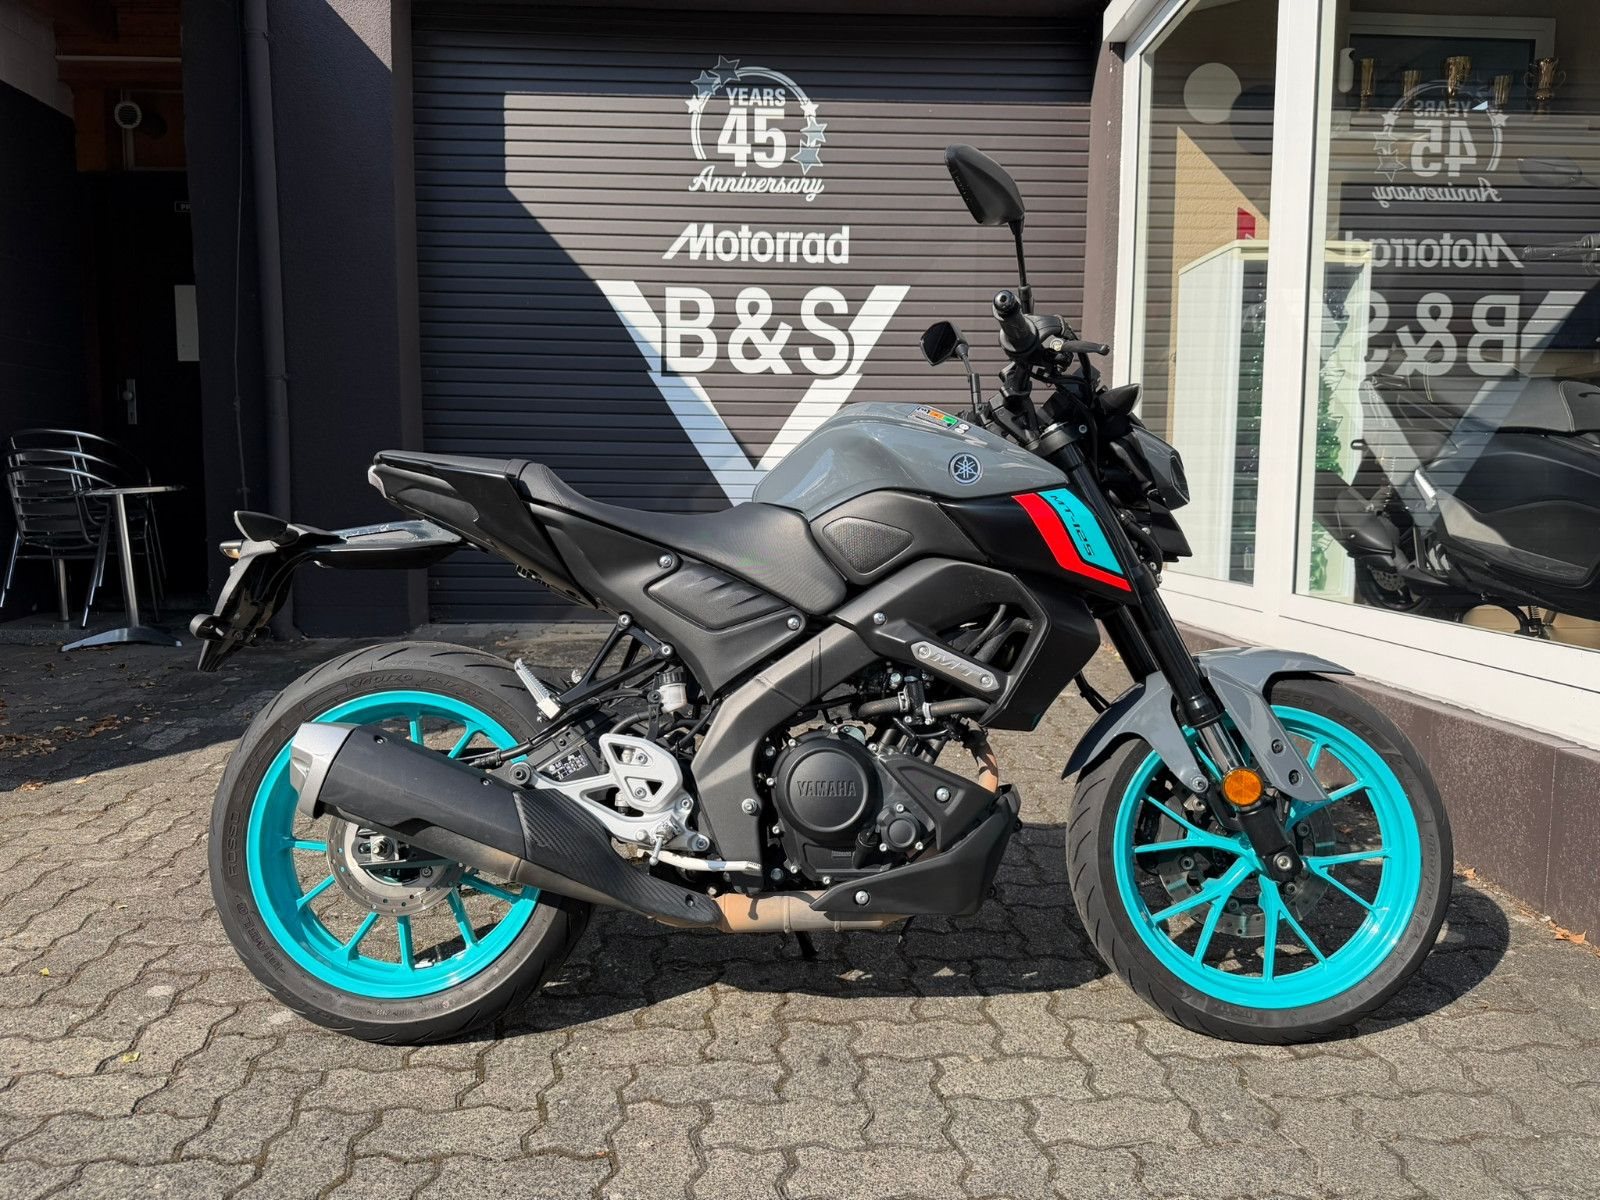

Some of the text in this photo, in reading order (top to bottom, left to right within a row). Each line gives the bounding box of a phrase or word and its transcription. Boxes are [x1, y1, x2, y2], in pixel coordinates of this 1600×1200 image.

[726, 87, 786, 107] YEARS
[717, 107, 787, 169] 45
[688, 165, 825, 202] Anniversary
[662, 223, 850, 265] Motorrad
[664, 286, 850, 375] B&S
[1050, 495, 1095, 557] MT-125
[928, 652, 983, 677] MT
[797, 780, 857, 797] YAMAHA
[227, 811, 241, 878] ROSSO
